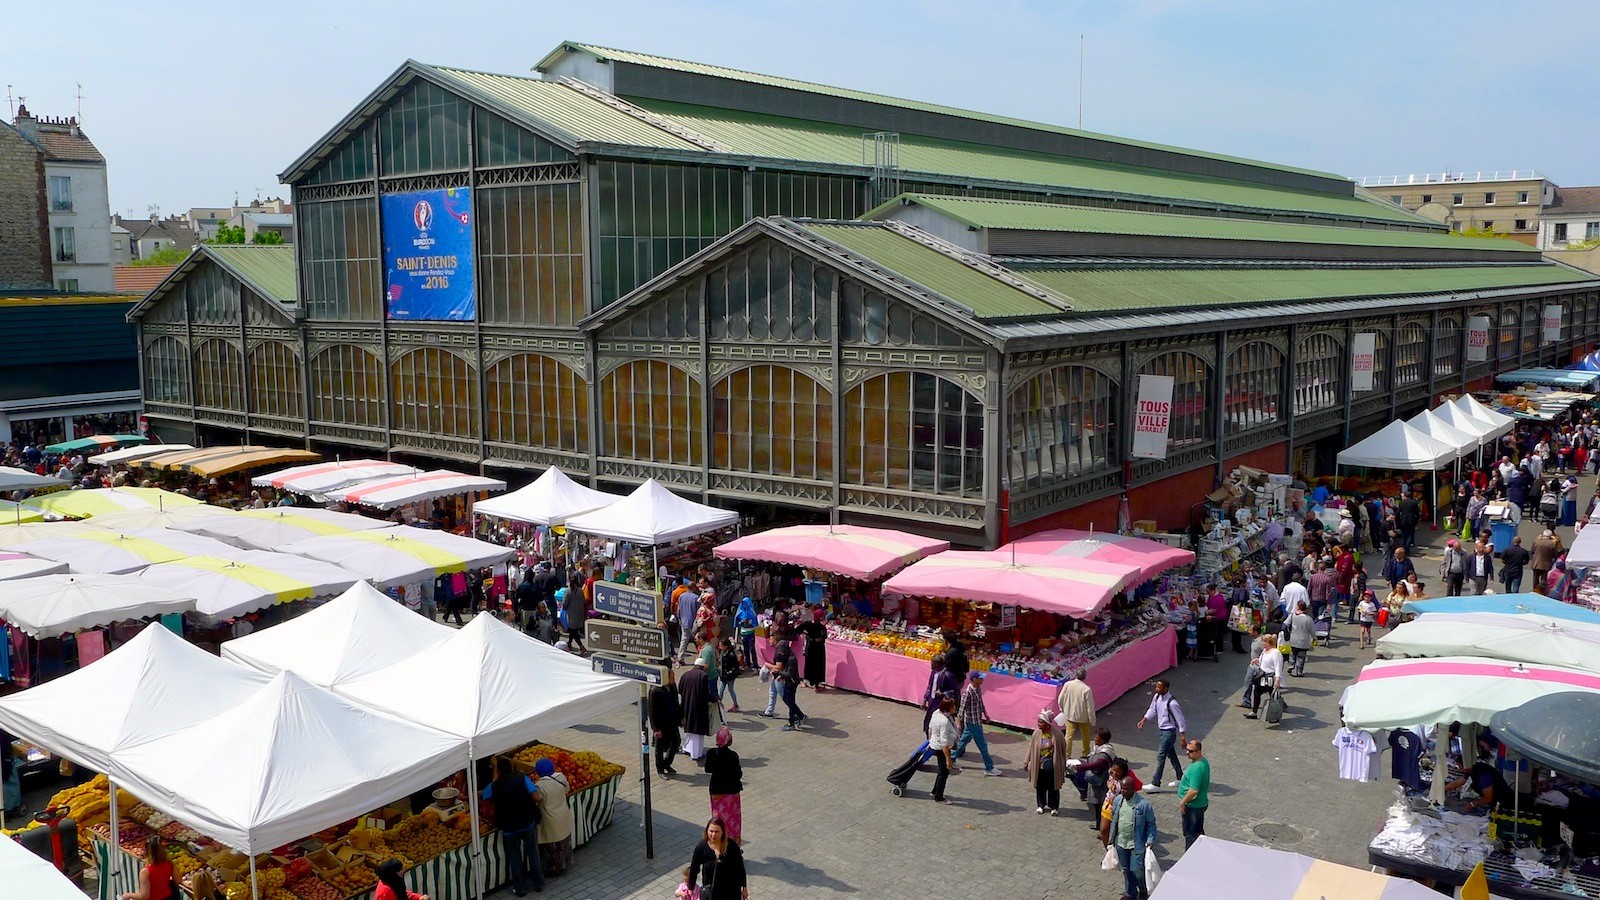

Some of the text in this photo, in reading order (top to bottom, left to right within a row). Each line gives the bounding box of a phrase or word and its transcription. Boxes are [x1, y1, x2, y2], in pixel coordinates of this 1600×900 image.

[397, 256, 458, 270] SAINT-DENIS
[426, 276, 448, 288] 2016
[1140, 401, 1168, 413] TOUS
[1138, 416, 1167, 427] VILLE
[618, 592, 653, 605] Métro Basilique
[618, 599, 630, 607] Hôtel
[639, 603, 650, 611] Ville
[618, 606, 629, 614] Office
[622, 630, 641, 638] Musée
[622, 645, 649, 654] Basilique
